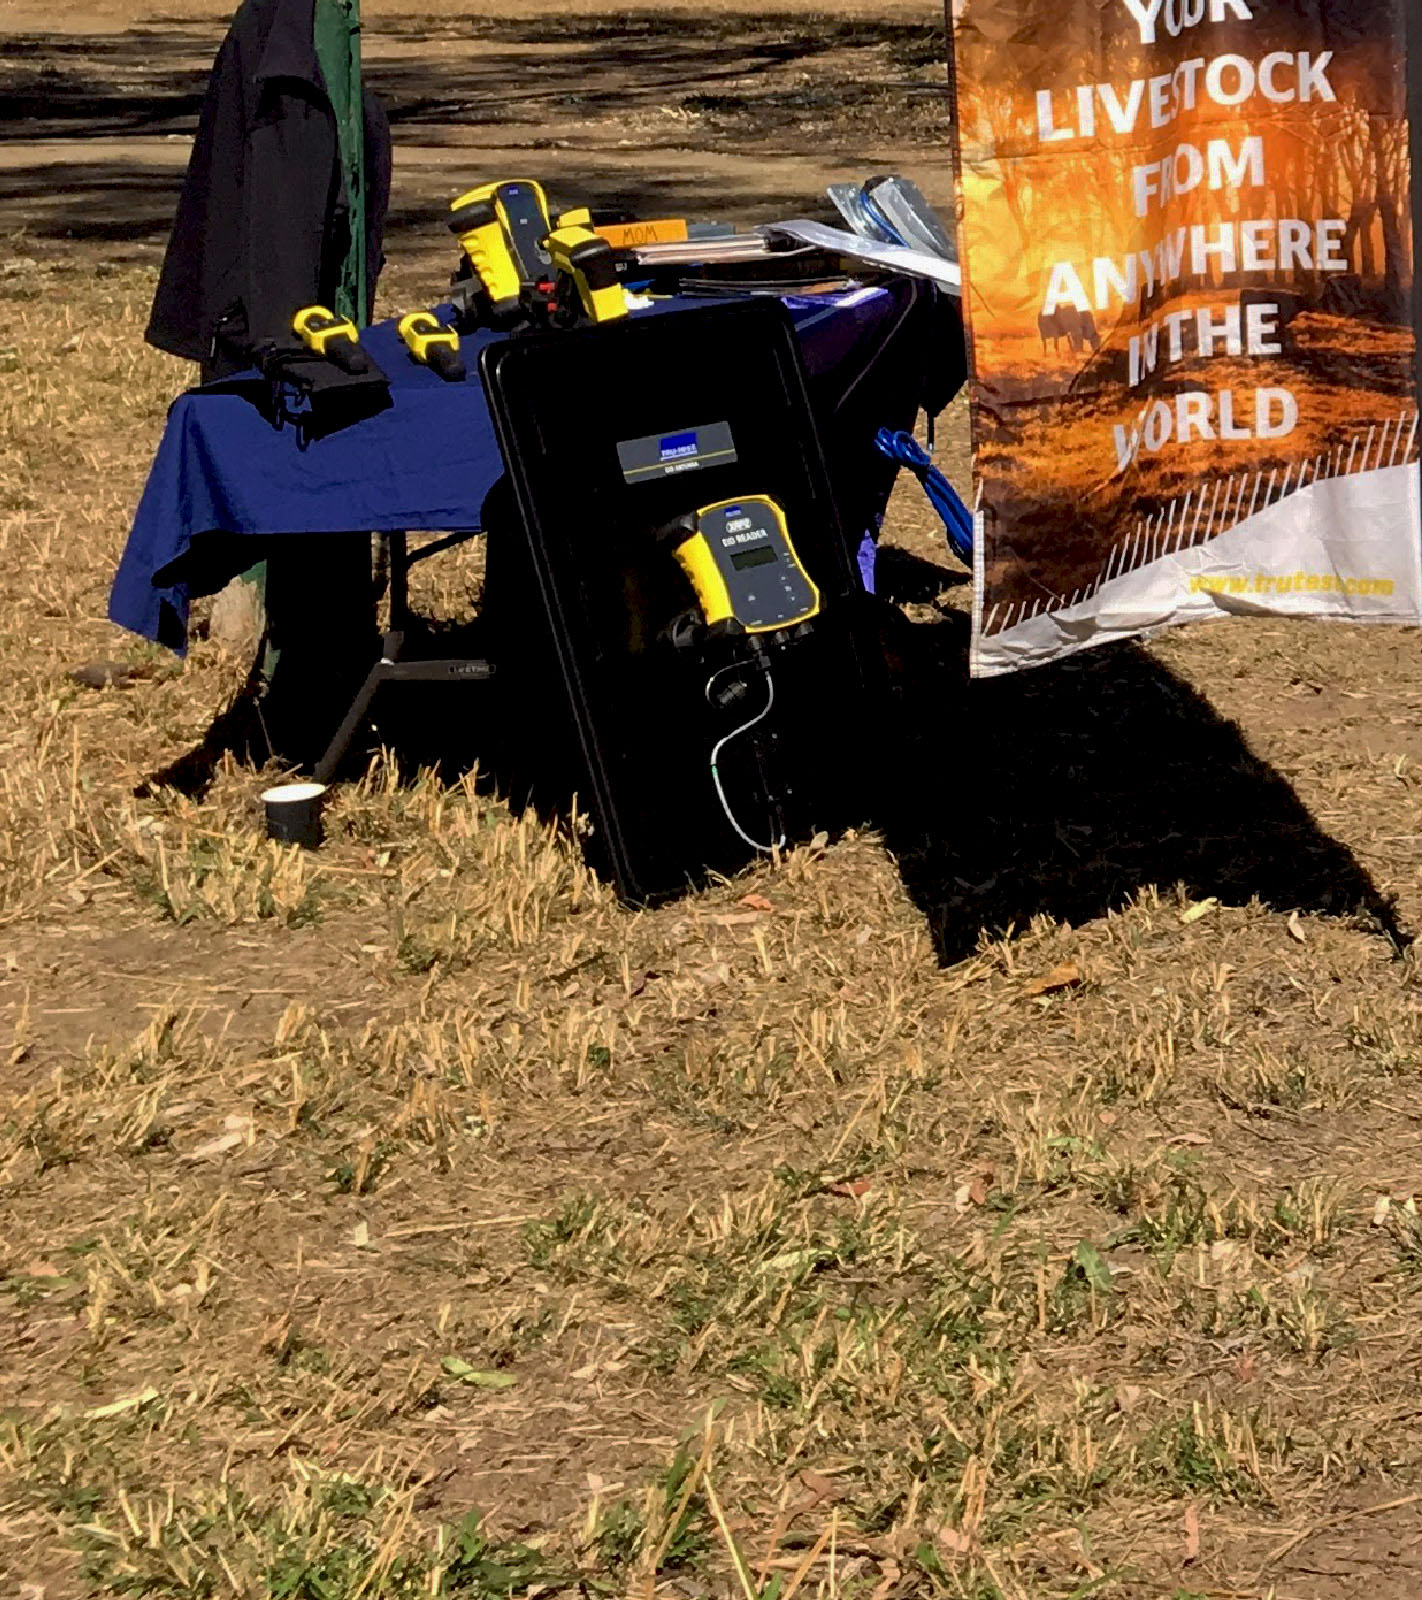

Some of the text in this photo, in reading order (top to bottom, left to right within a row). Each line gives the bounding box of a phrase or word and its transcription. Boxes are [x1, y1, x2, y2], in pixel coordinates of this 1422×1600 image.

[1035, 50, 1337, 143] LIVESTOCK
[622, 225, 658, 244] MOM
[1041, 218, 1348, 317] ANYWHERE
[1163, 303, 1282, 364] THE
